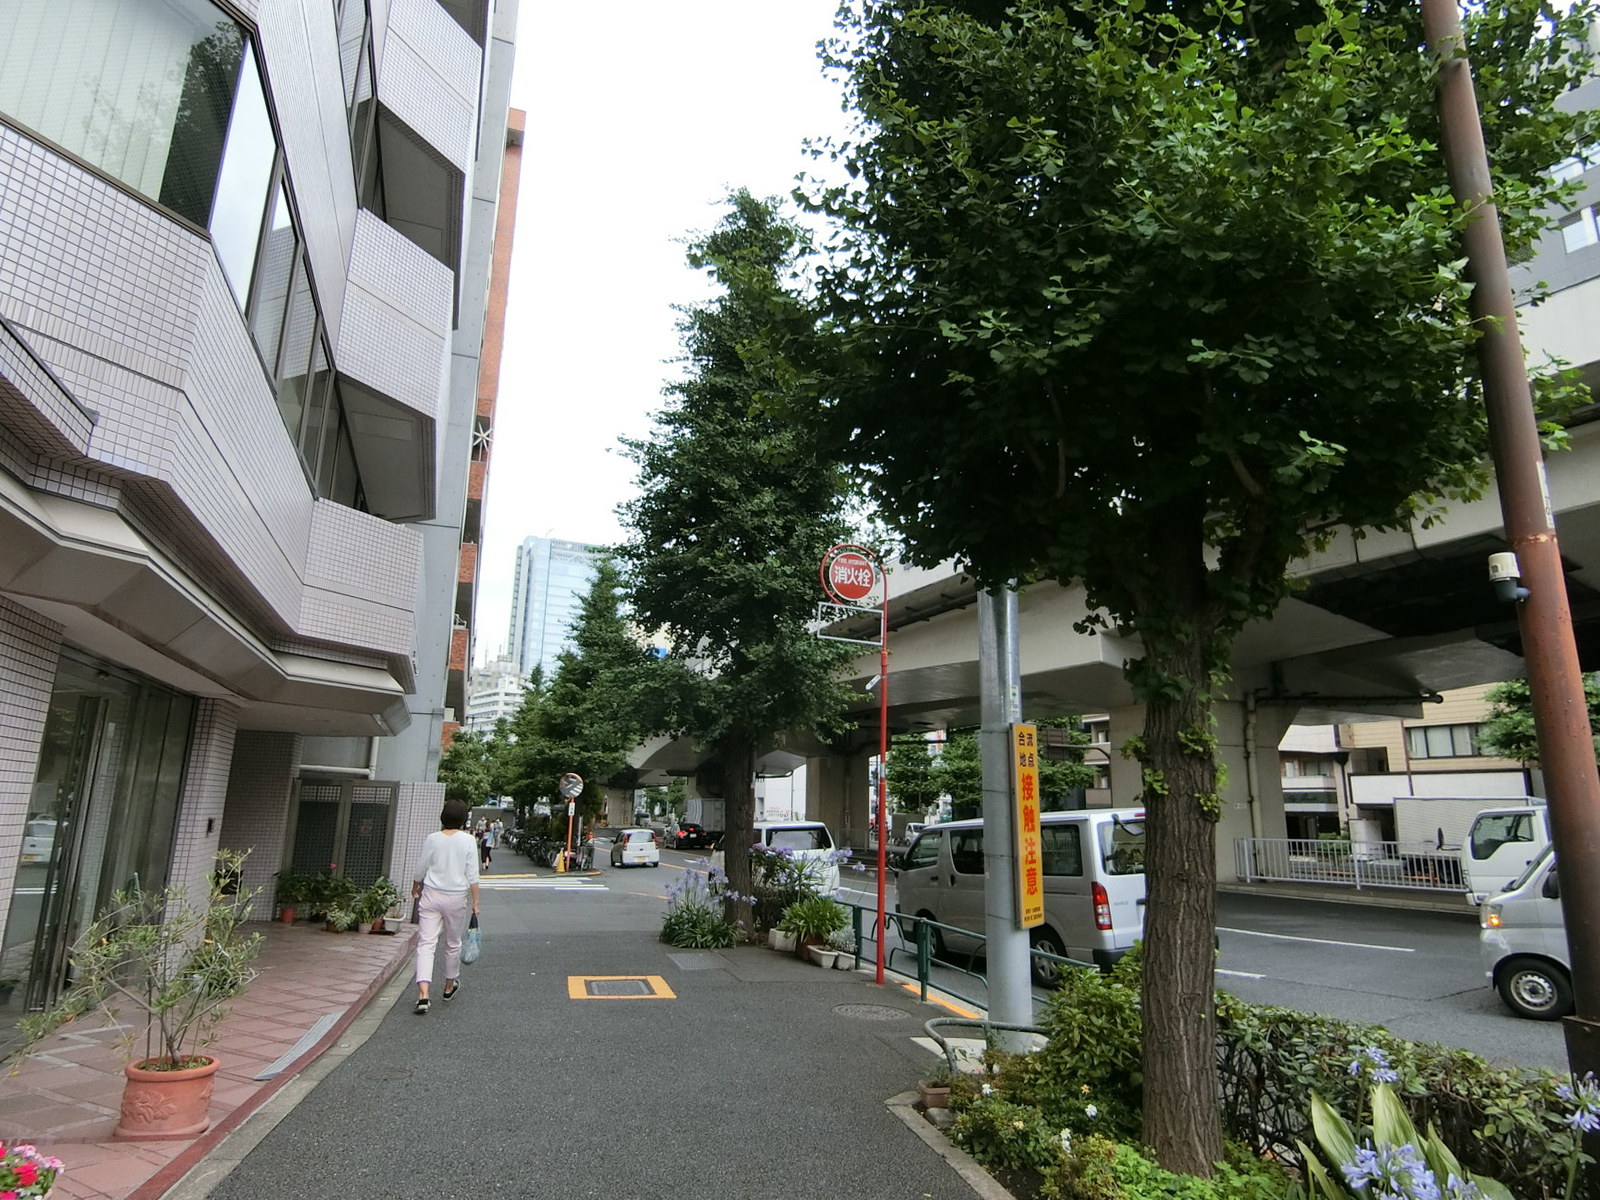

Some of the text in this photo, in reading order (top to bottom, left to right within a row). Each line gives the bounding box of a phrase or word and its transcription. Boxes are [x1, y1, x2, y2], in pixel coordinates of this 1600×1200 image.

[834, 565, 871, 587] 消火栓
[1018, 731, 1034, 747] 合流
[1019, 752, 1036, 768] 地点
[1021, 773, 1039, 896] 接触注意
